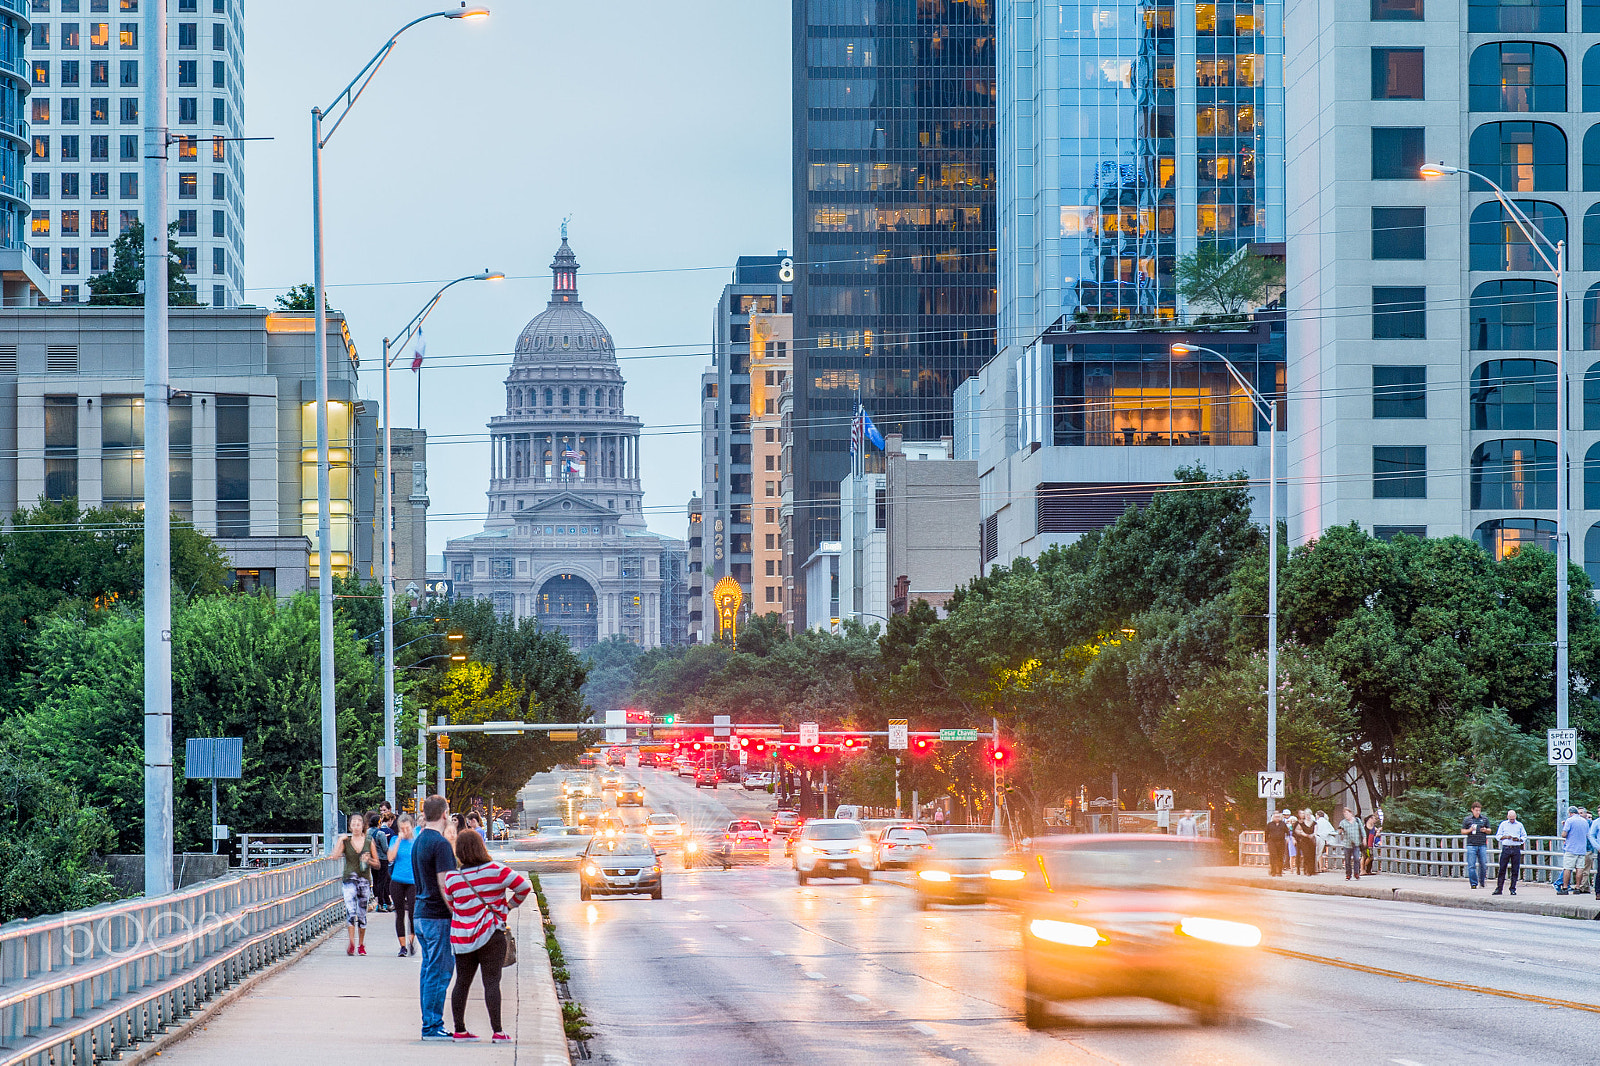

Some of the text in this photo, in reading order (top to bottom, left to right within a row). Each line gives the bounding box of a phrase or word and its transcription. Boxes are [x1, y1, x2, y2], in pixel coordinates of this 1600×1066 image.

[779, 258, 794, 282] 8
[715, 519, 724, 560] 823
[1552, 748, 1573, 760] 30
